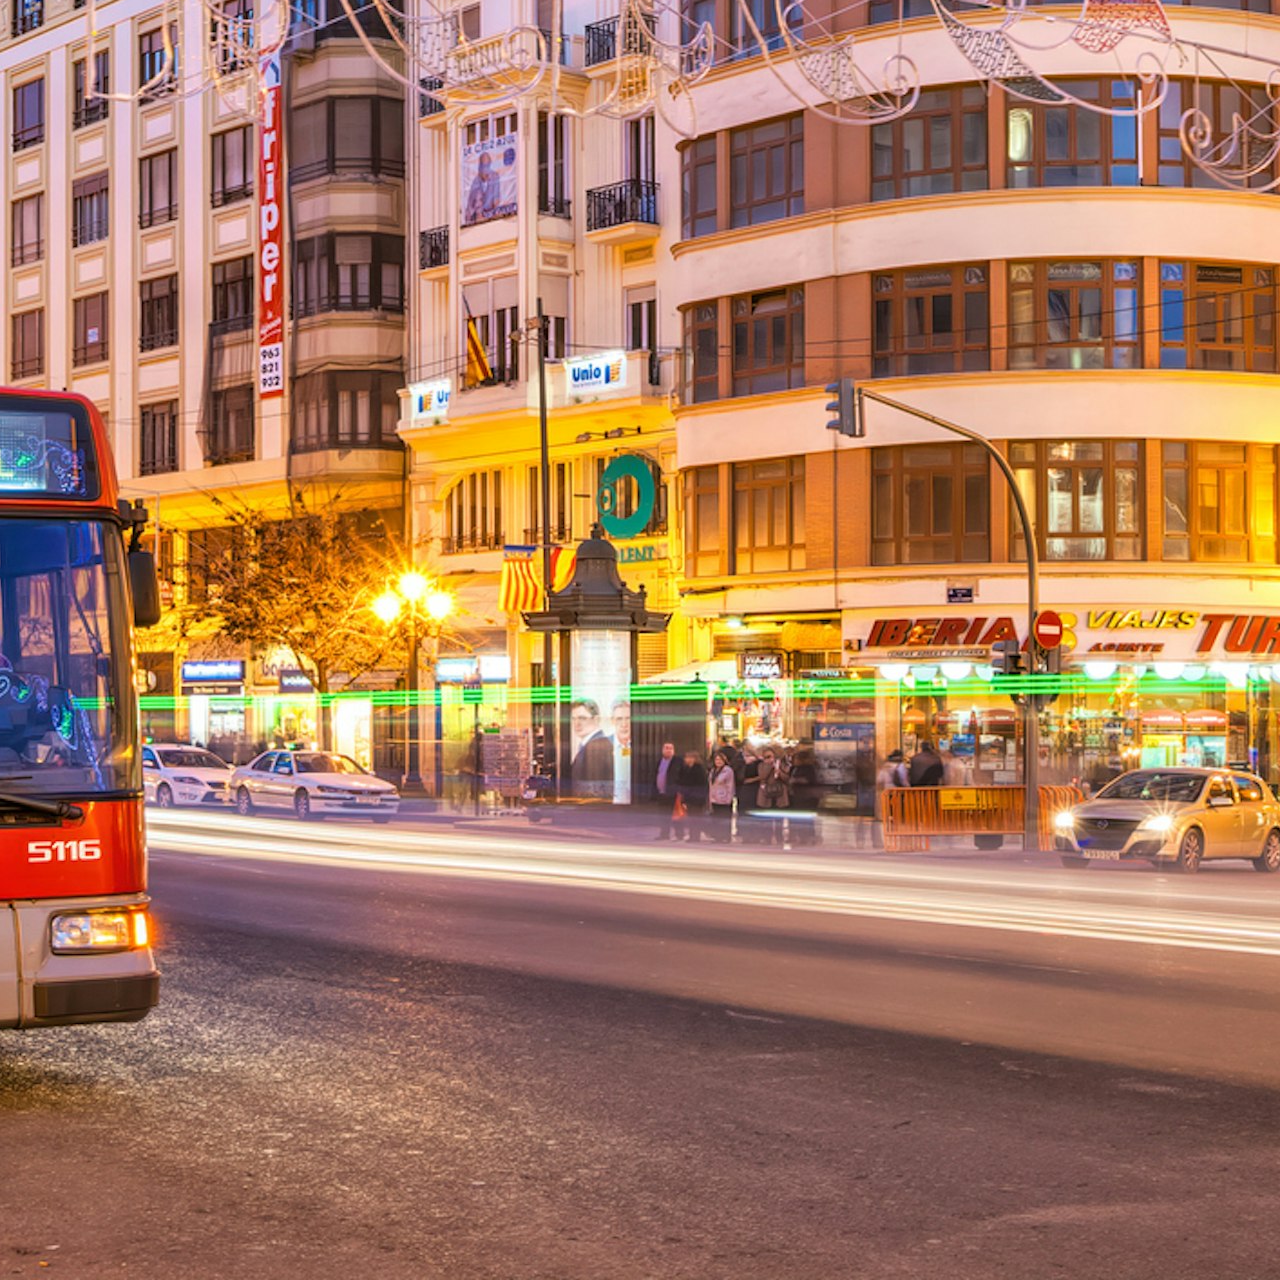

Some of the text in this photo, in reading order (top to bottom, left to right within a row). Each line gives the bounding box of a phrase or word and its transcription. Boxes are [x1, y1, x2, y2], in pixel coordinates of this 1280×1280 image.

[572, 363, 601, 383] Unio
[1087, 608, 1200, 631] VIAJES
[865, 616, 1019, 647] IBERIA
[27, 839, 102, 863] 5116
